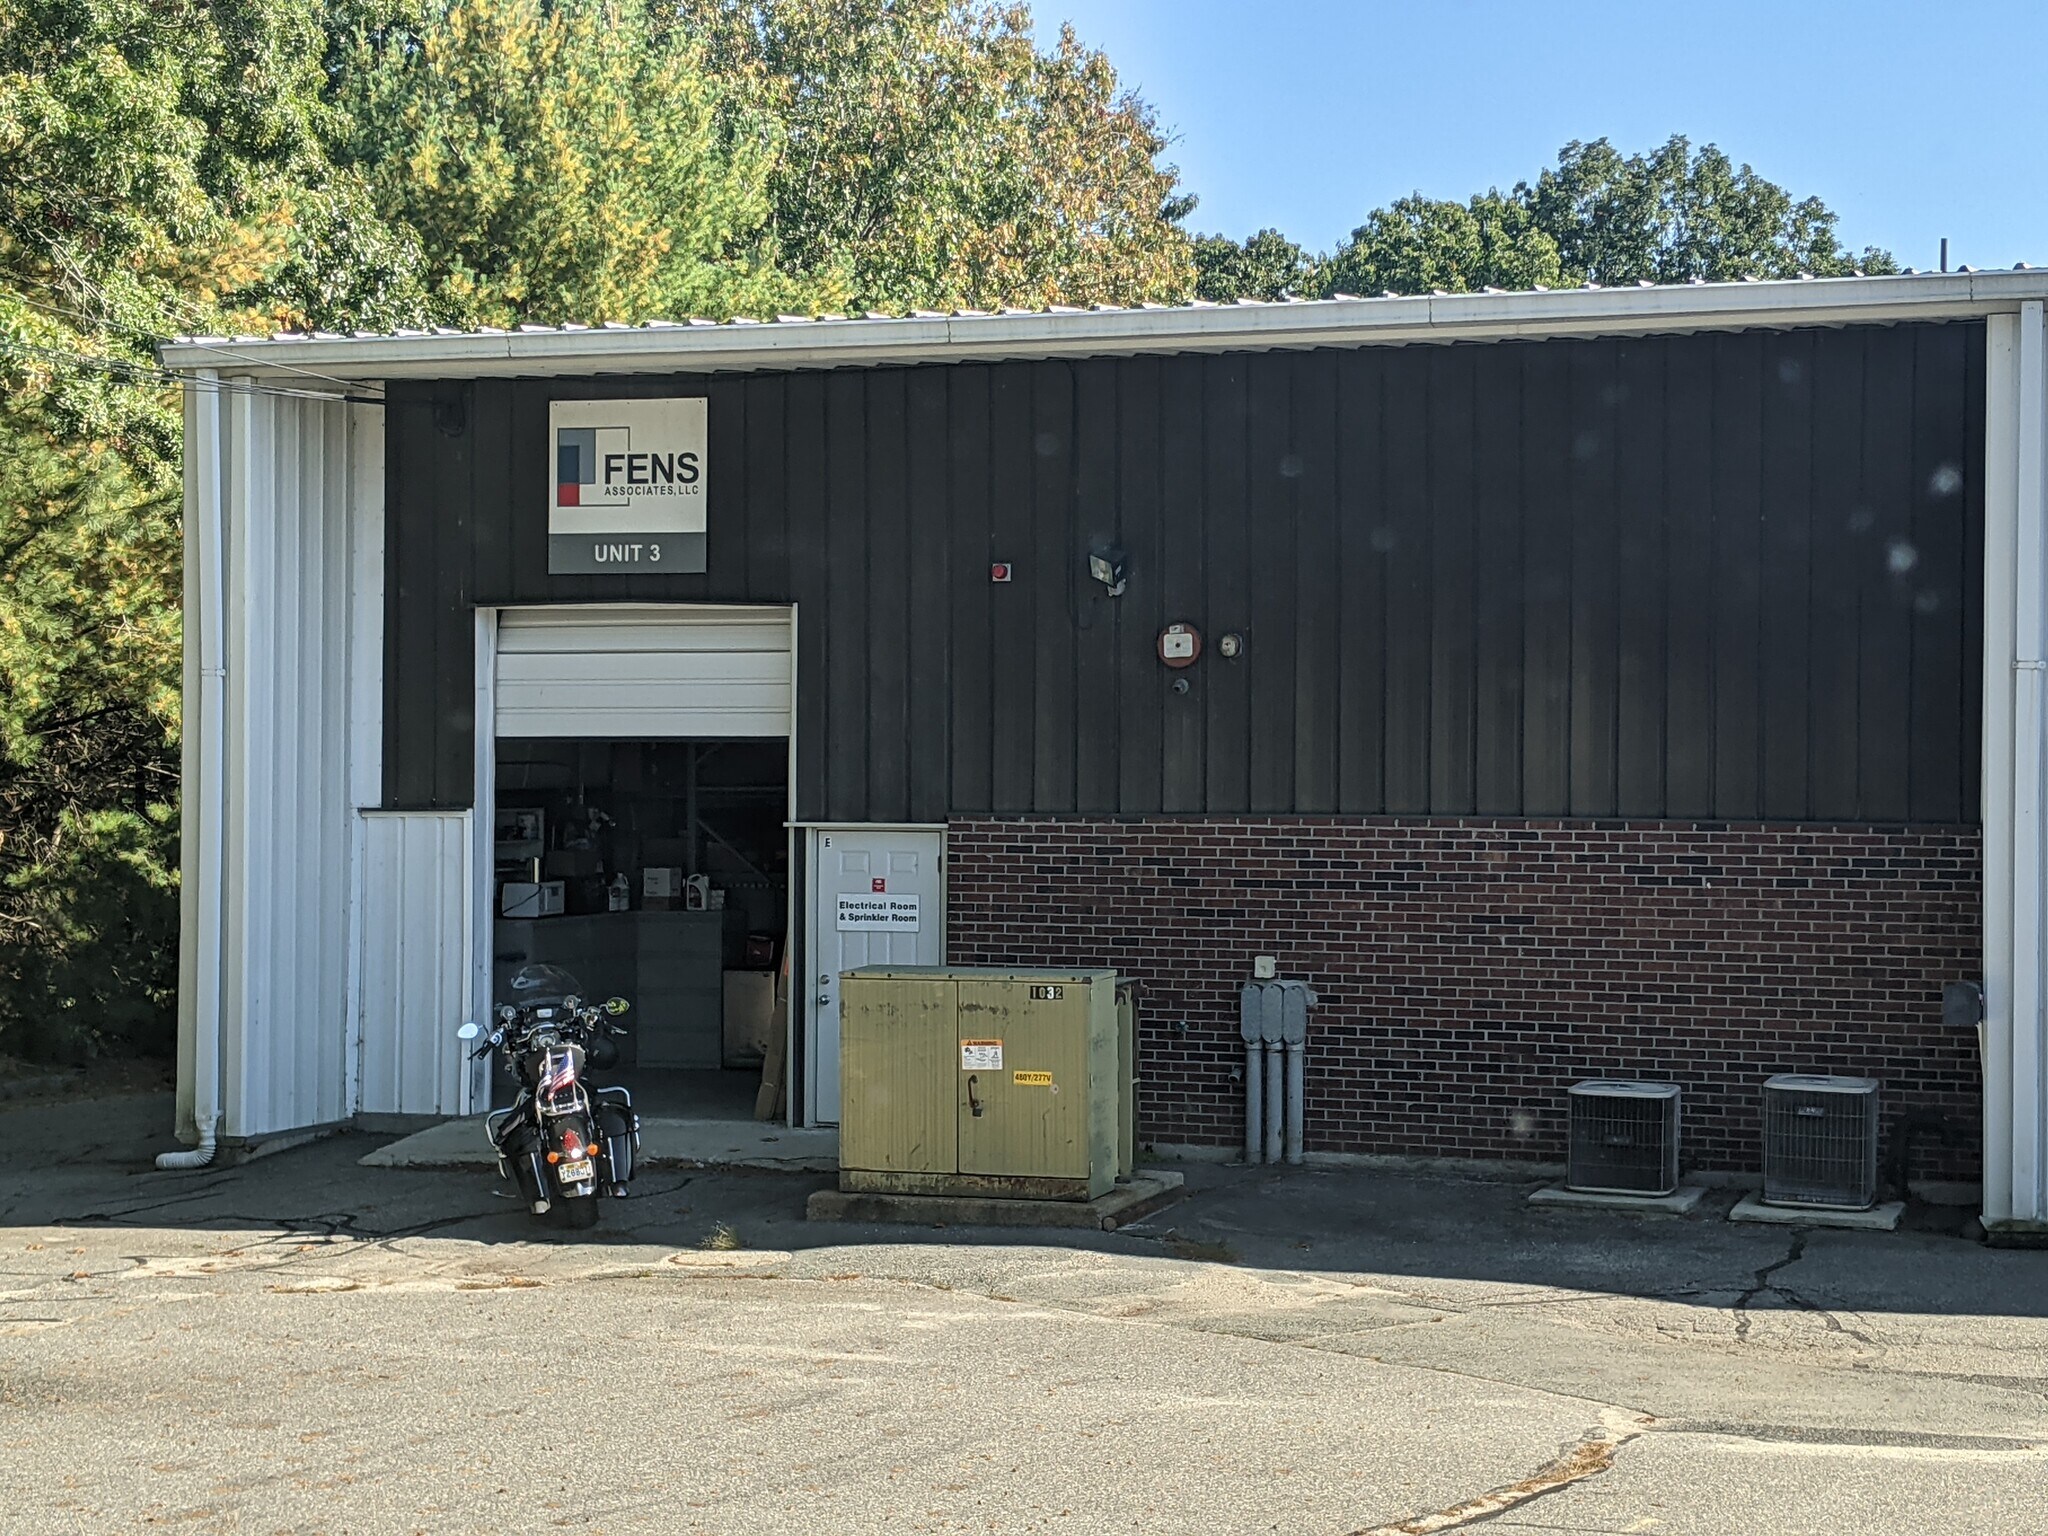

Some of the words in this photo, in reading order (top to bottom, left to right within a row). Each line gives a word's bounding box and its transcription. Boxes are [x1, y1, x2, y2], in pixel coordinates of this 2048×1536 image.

[604, 452, 699, 484] FENS
[594, 544, 643, 562] UNIT
[650, 544, 661, 562] 3
[839, 901, 886, 910] Electrical
[890, 902, 917, 910] Room
[839, 912, 846, 921] &
[848, 913, 889, 922] Sprinkler
[891, 914, 917, 922] Room
[1032, 986, 1062, 999] 1032
[1015, 1073, 1051, 1082] 480Y/277V
